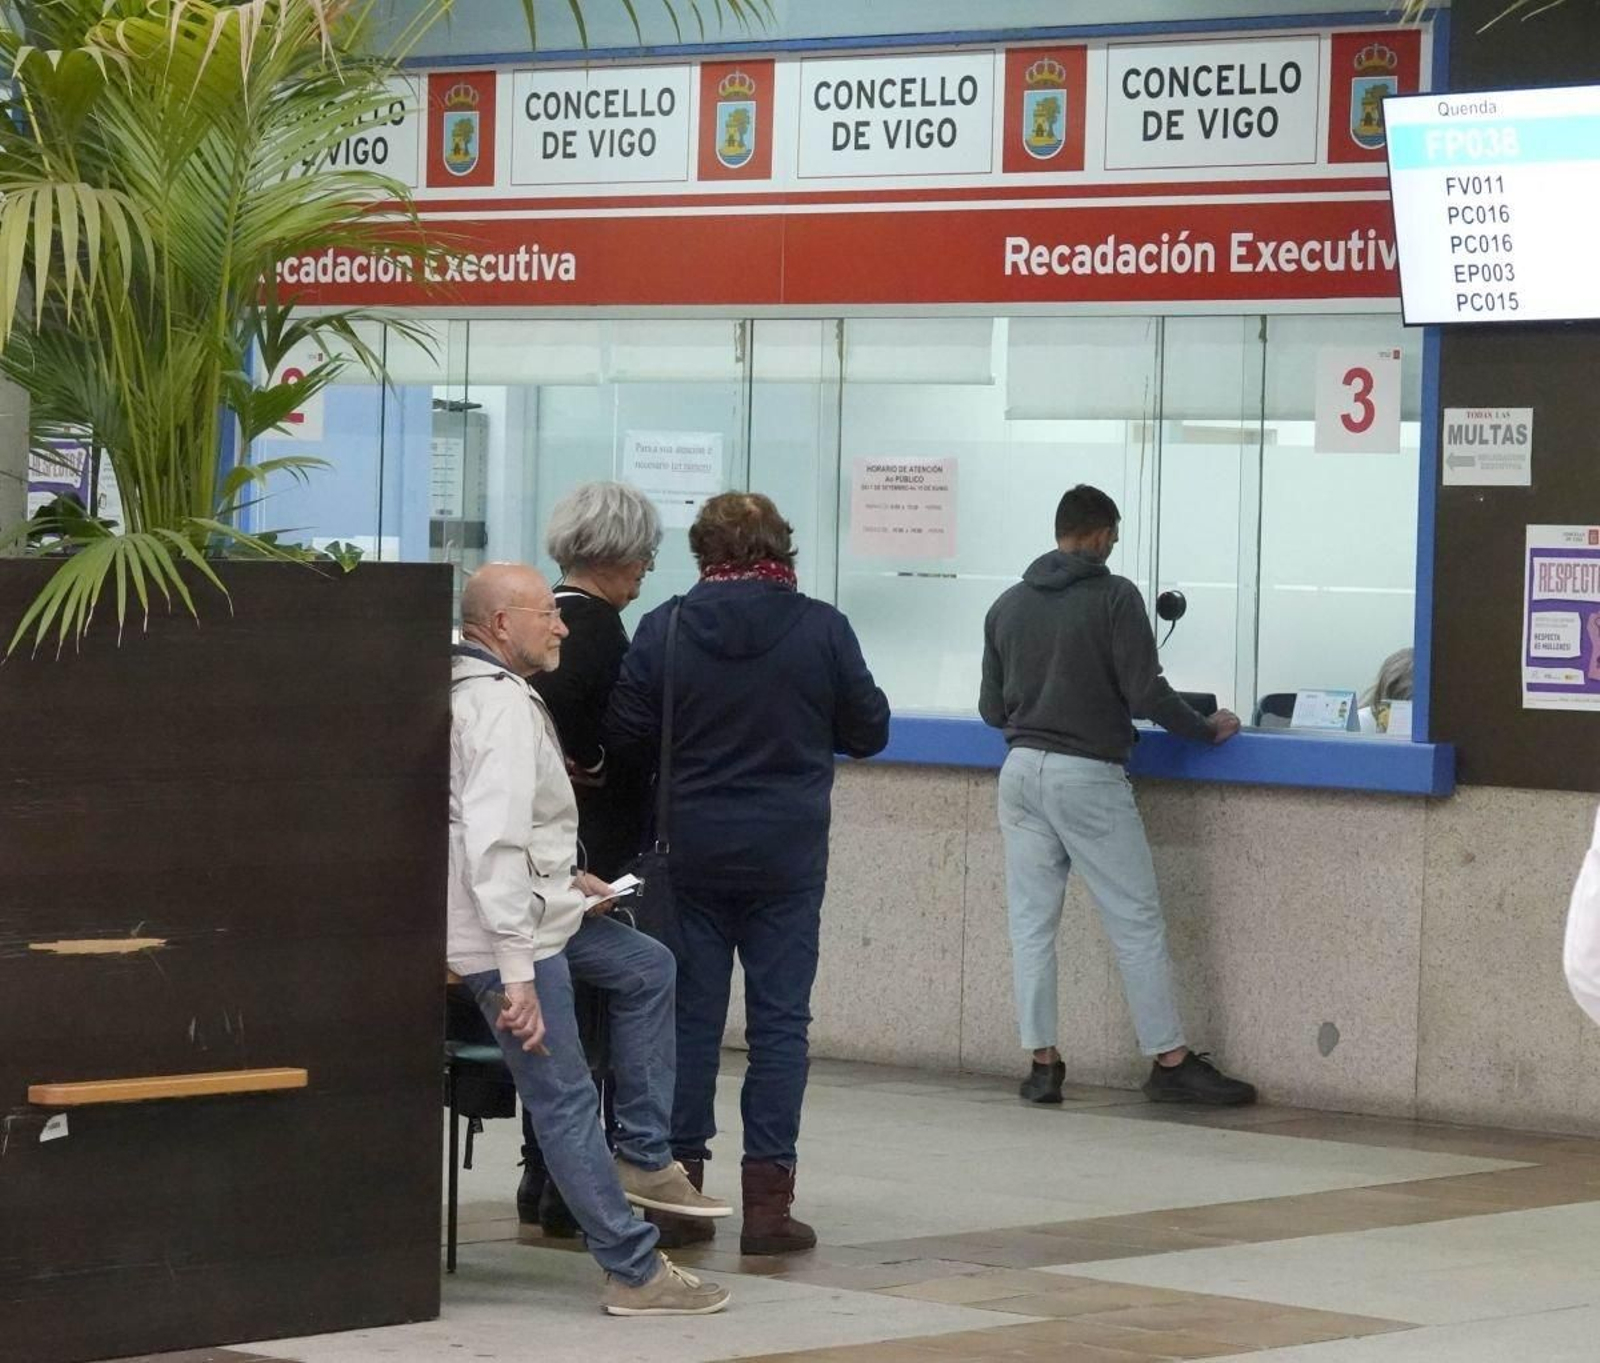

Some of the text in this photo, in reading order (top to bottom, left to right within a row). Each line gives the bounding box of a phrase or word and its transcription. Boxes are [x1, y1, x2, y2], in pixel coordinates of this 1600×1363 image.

[814, 75, 978, 111] CONCELLO
[1122, 61, 1301, 99] CONCELLO
[525, 87, 675, 121] CONCELLO
[1437, 100, 1497, 117] Quenda
[832, 117, 957, 151] DE VIGO
[1142, 106, 1279, 141] DE VIGO
[542, 127, 657, 159] DE VIGO
[1445, 175, 1505, 196] FV011
[1448, 204, 1510, 225] PC016
[1004, 228, 1398, 276] Recadación Executiv
[1450, 234, 1513, 254] PC016
[259, 243, 576, 284] cadación Executiva
[1454, 263, 1516, 283] EP003
[1456, 292, 1520, 312] PC015
[1340, 367, 1376, 434] 3
[1448, 423, 1528, 446] MULTAS
[866, 465, 897, 473] HORARIO
[899, 465, 907, 473] DE
